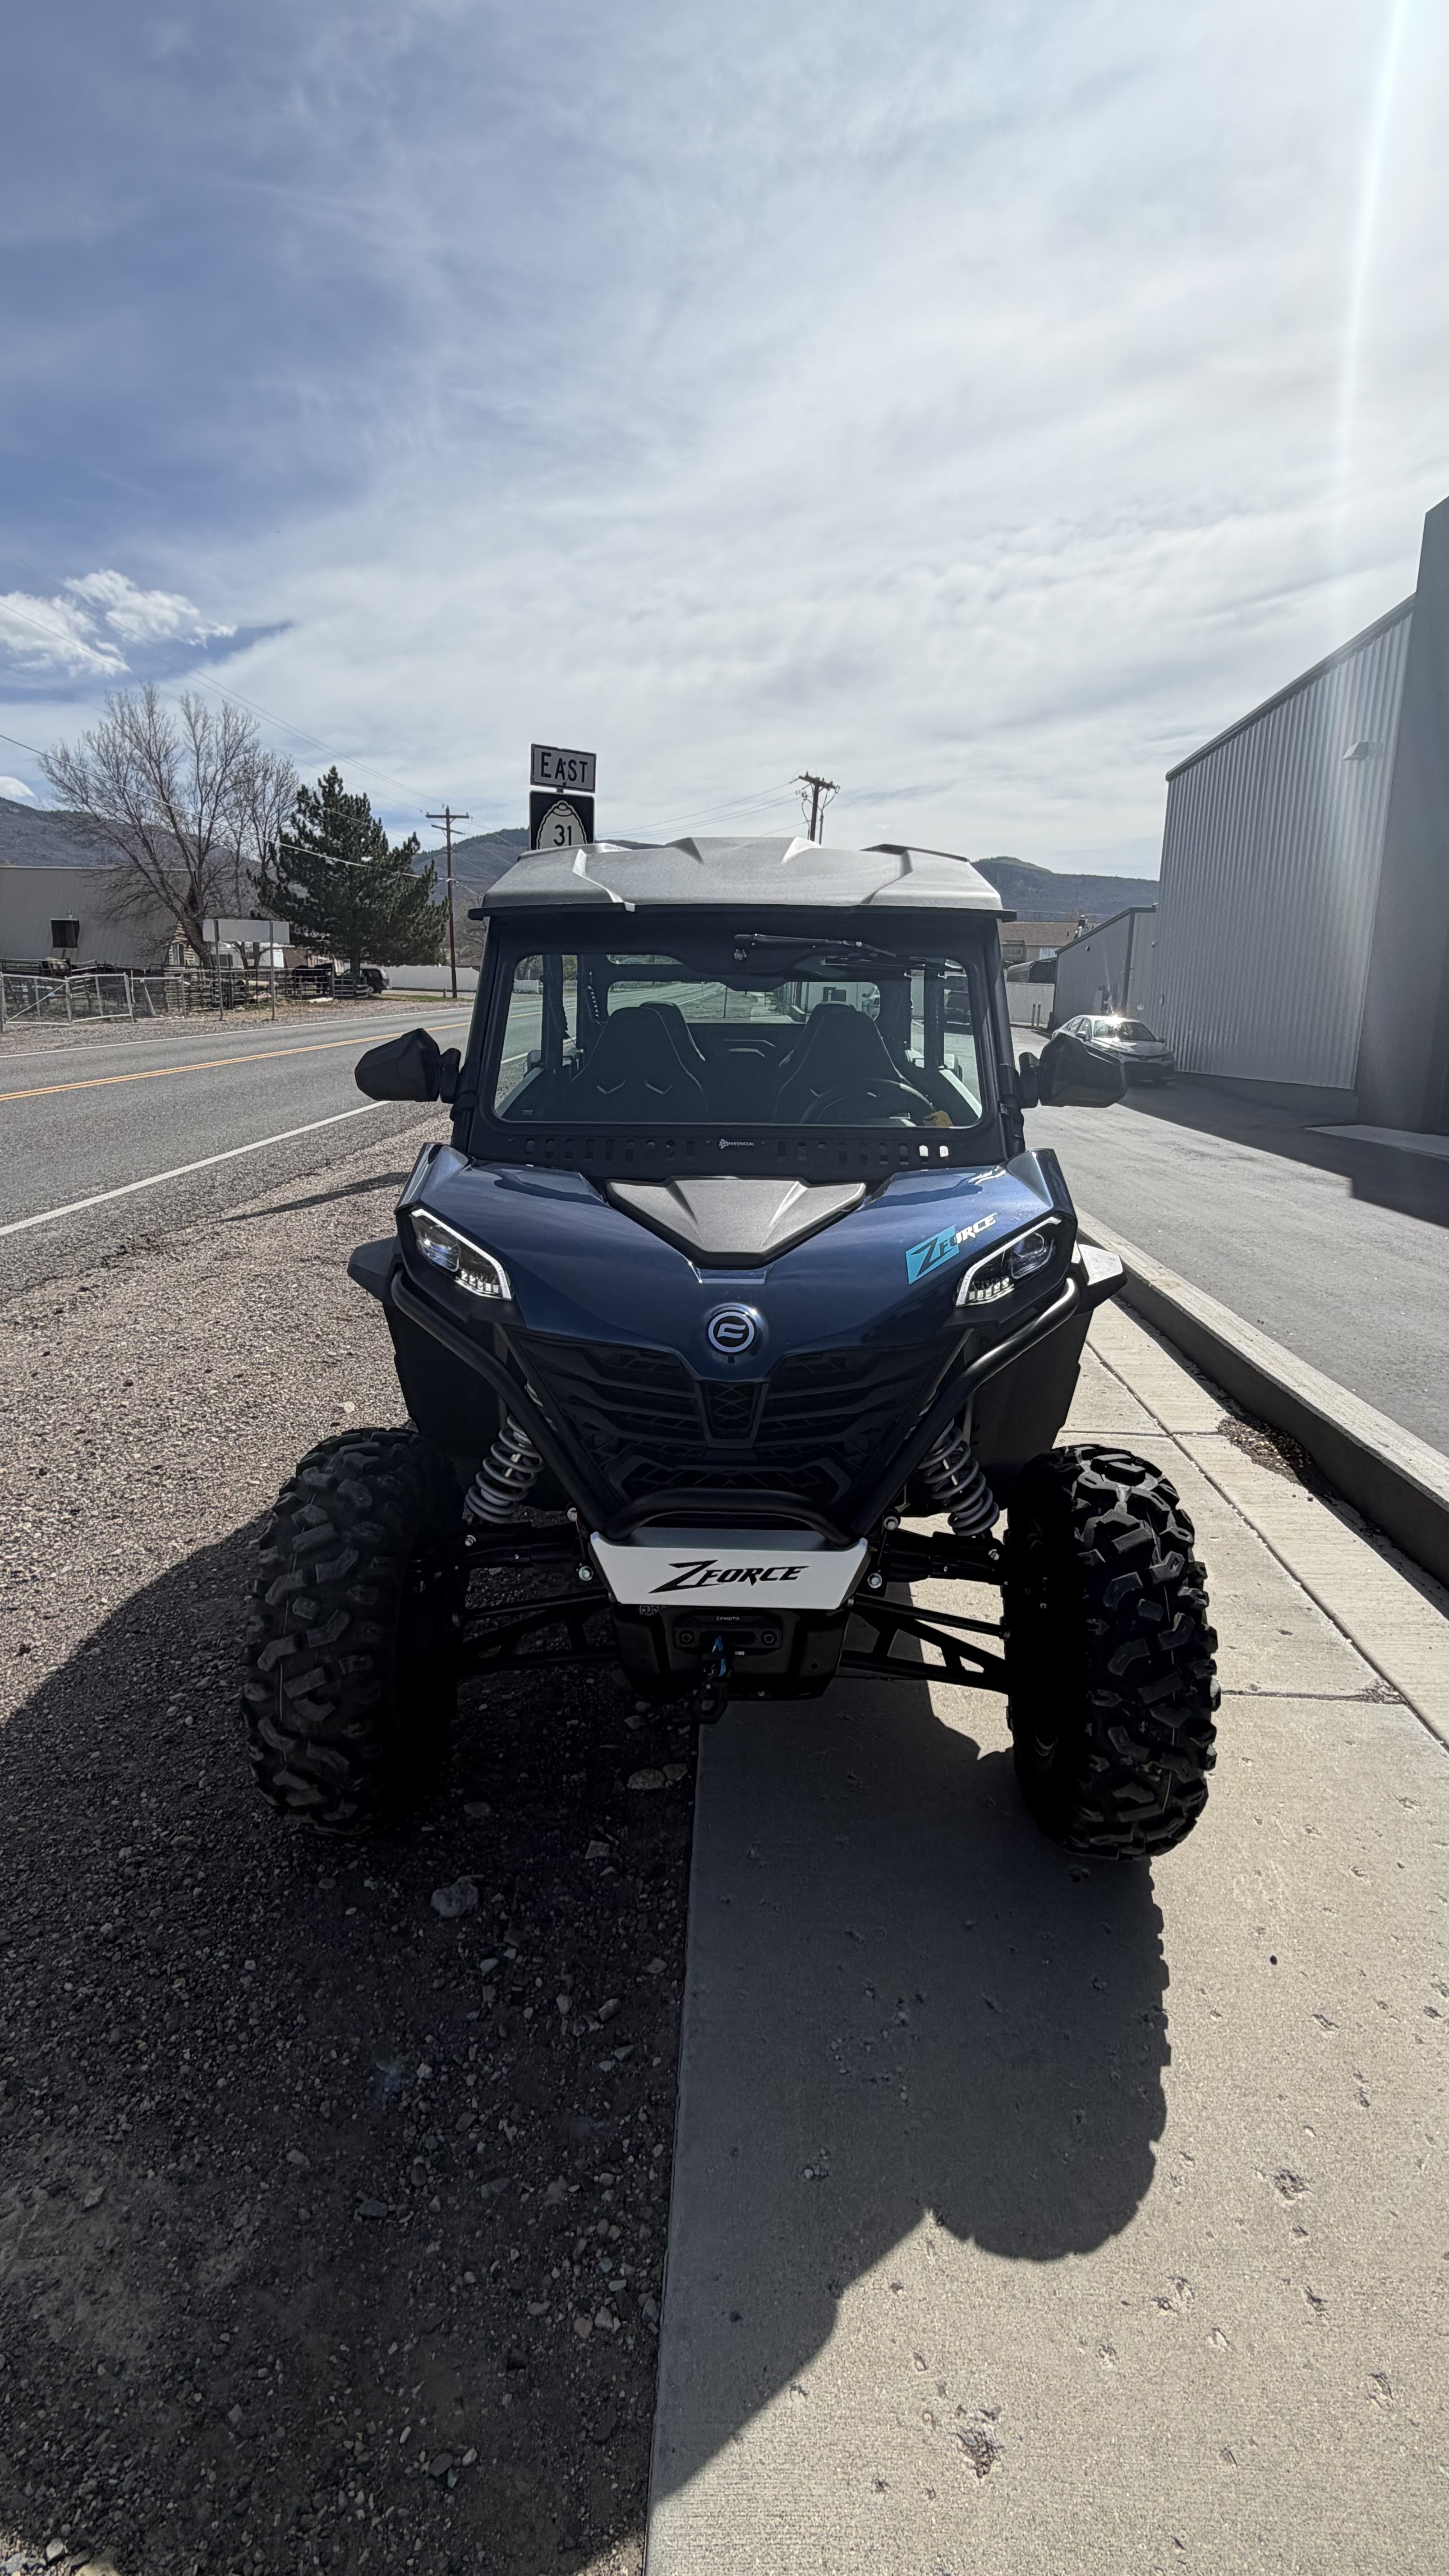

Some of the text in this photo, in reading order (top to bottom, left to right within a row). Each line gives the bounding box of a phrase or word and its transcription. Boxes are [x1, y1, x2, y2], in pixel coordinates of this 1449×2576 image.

[541, 752, 588, 782] EAST
[553, 824, 572, 846] 31
[911, 1212, 998, 1278] ZFORCE
[647, 1559, 810, 1594] ZFORCE
